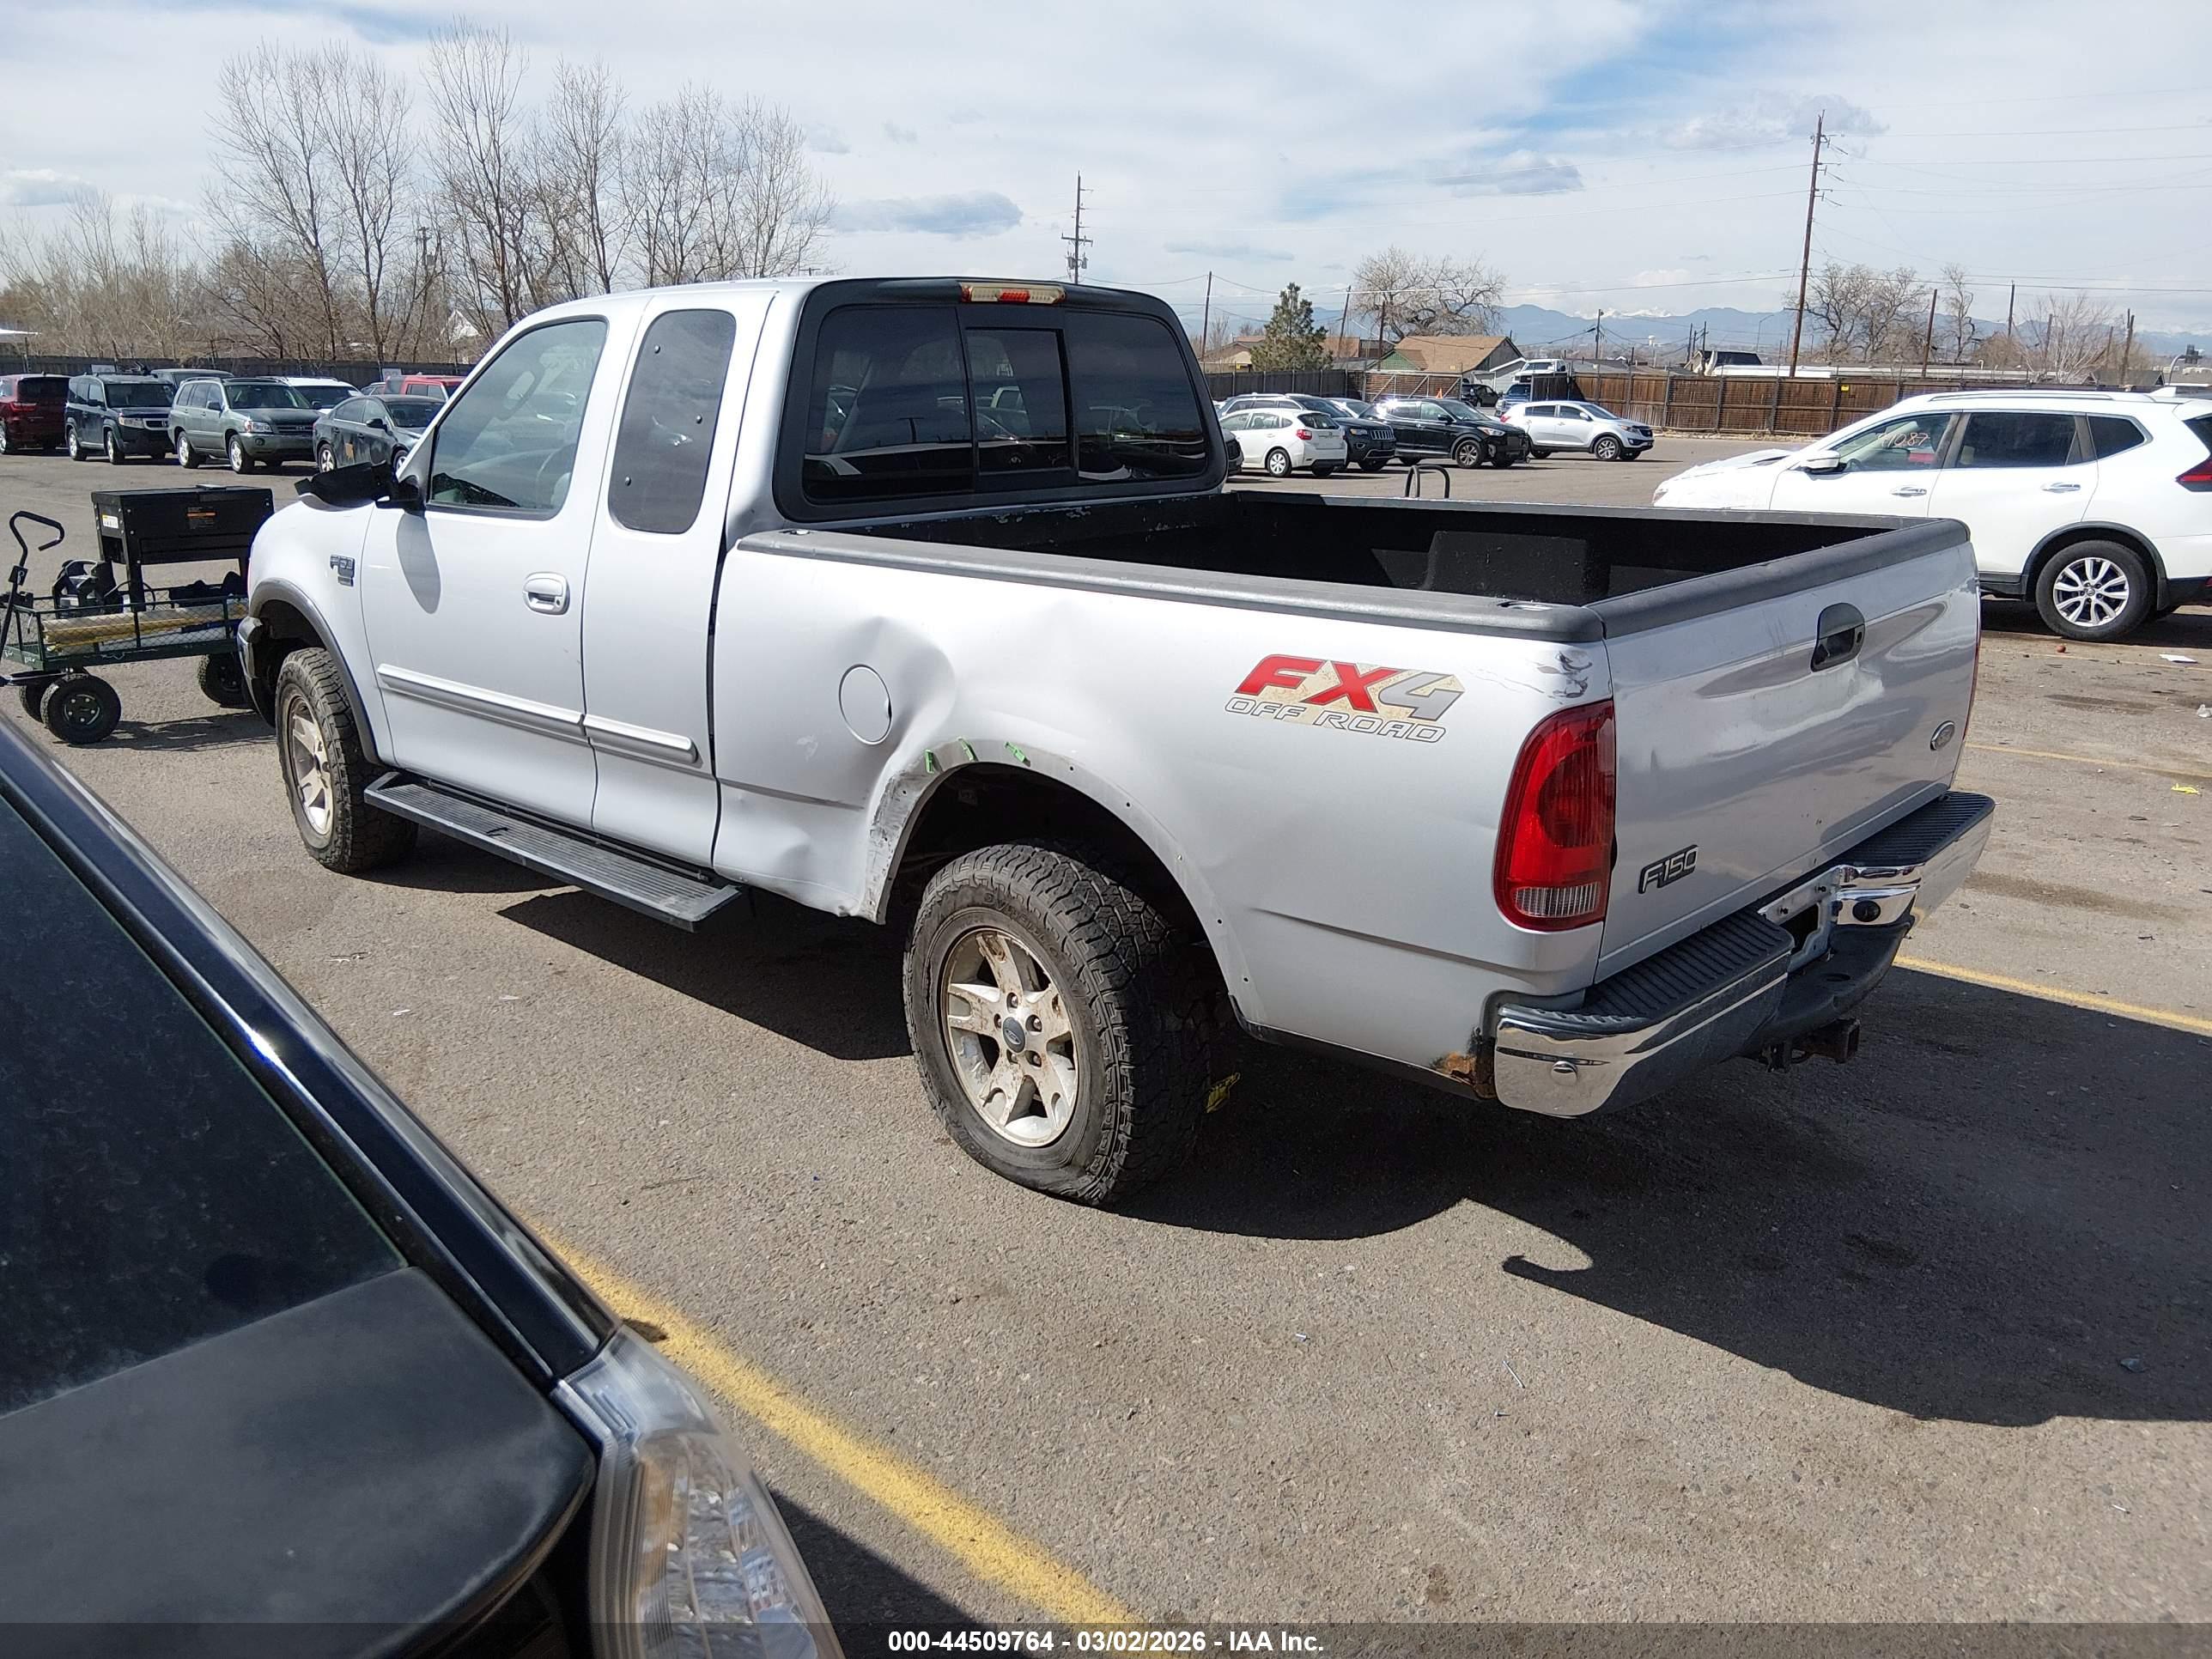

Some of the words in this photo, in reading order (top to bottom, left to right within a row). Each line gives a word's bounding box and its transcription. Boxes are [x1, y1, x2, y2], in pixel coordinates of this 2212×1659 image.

[1234, 653, 1465, 721] FX4
[1224, 696, 1307, 720] OFF
[1312, 710, 1446, 744] ROAD
